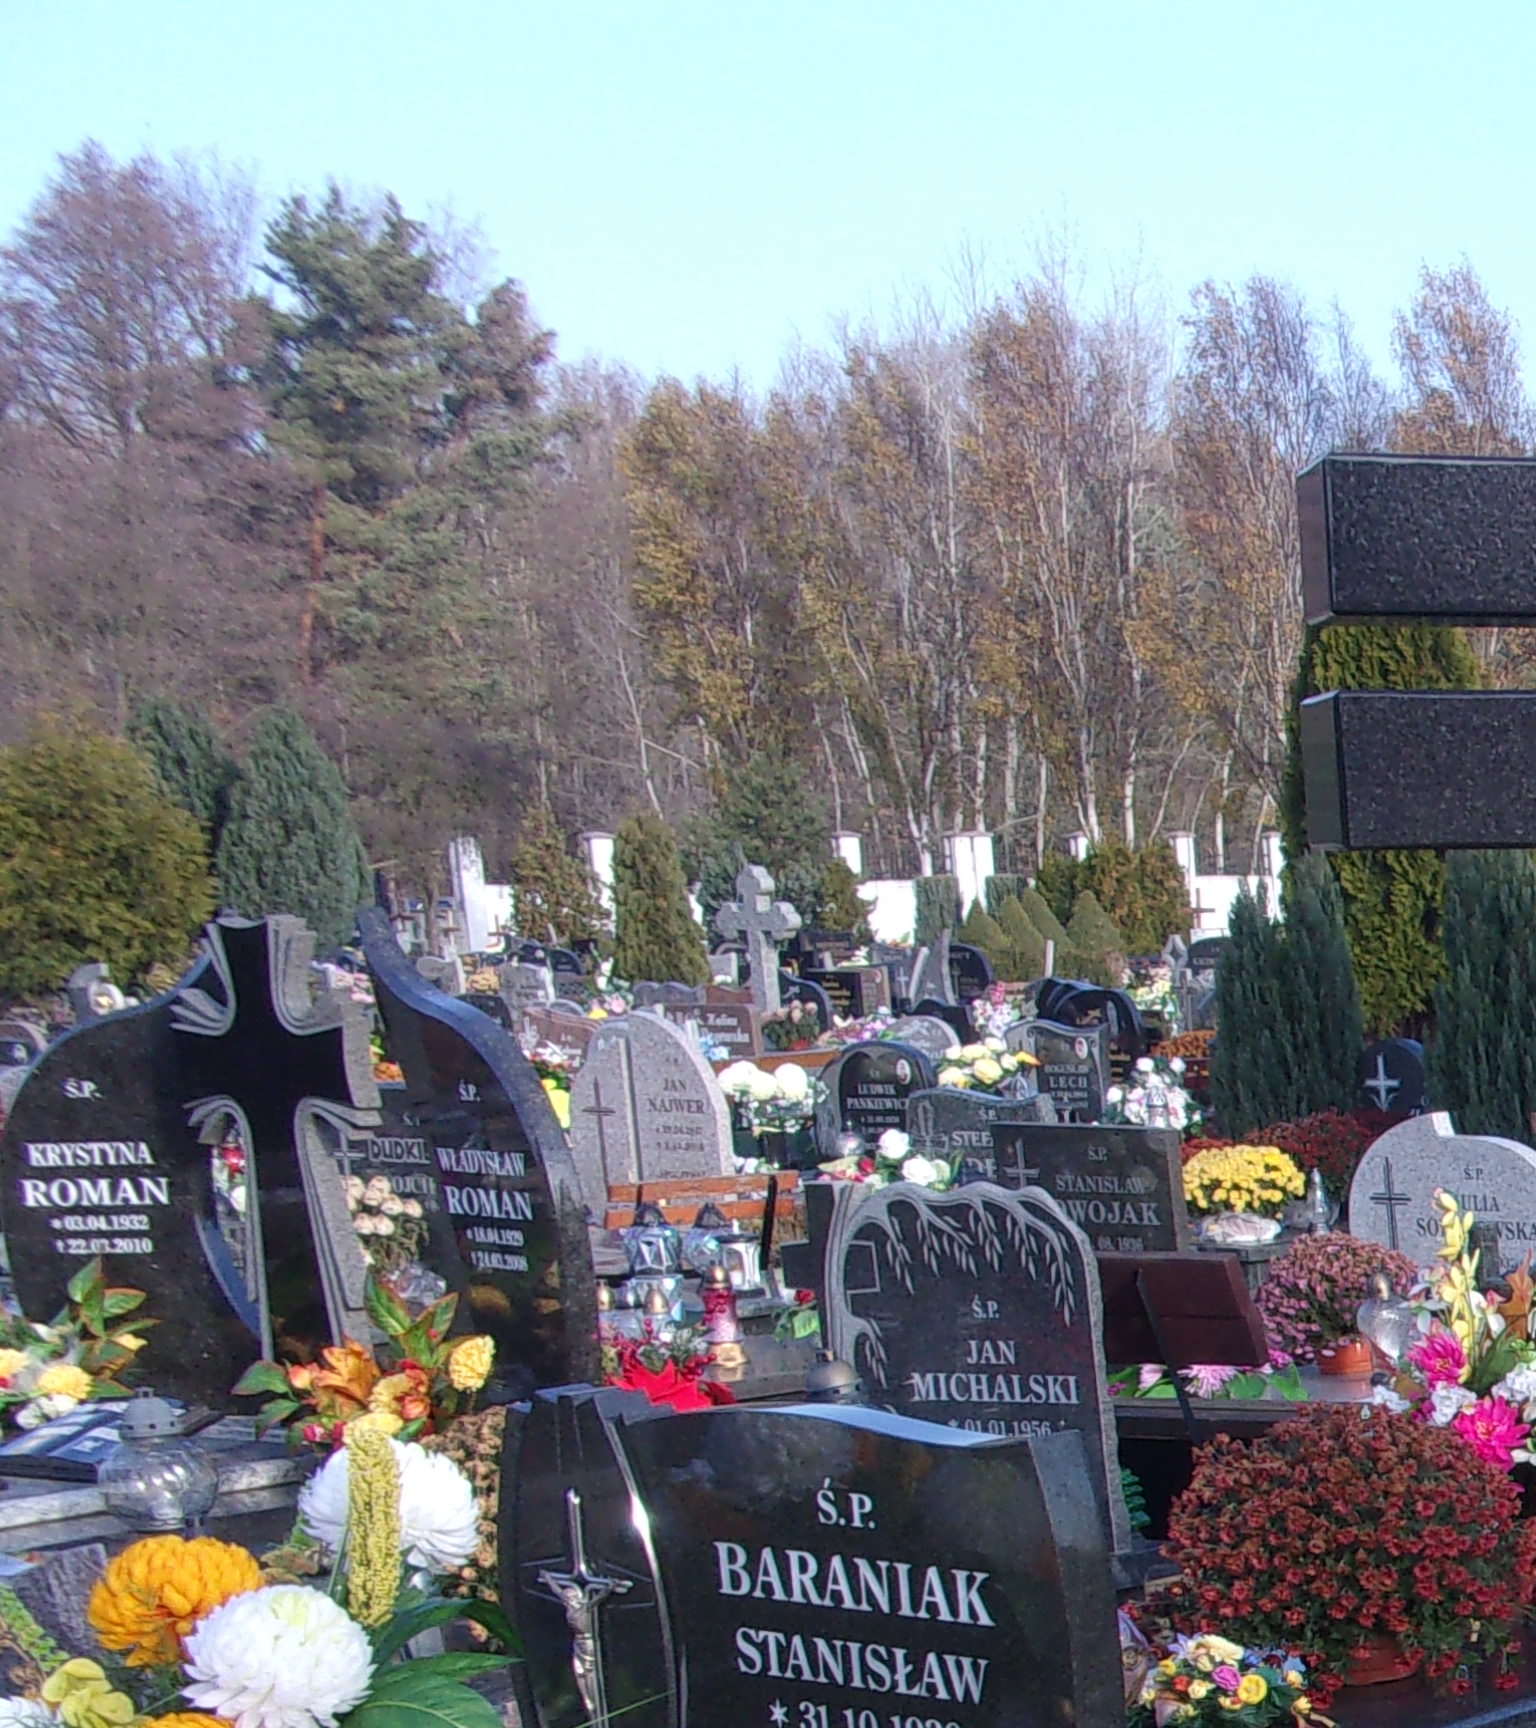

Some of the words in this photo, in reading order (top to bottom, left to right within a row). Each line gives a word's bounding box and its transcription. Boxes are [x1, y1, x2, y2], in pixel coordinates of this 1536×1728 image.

[661, 1078, 688, 1092] JAN
[648, 1098, 705, 1115] NAJWER
[24, 1141, 155, 1167] KRYSTYNA
[436, 1147, 525, 1177] WŁADYSŁAW
[20, 1177, 172, 1207] ROMAN
[443, 1185, 533, 1221] ROMAN
[1459, 1195, 1500, 1213] ULIA
[967, 1340, 1016, 1364] JAN
[910, 1372, 1080, 1405] MICHALSKI
[816, 1476, 877, 1530] Ś.P.
[713, 1540, 997, 1628] BARANIAK
[735, 1626, 990, 1706] STANISŁAW
